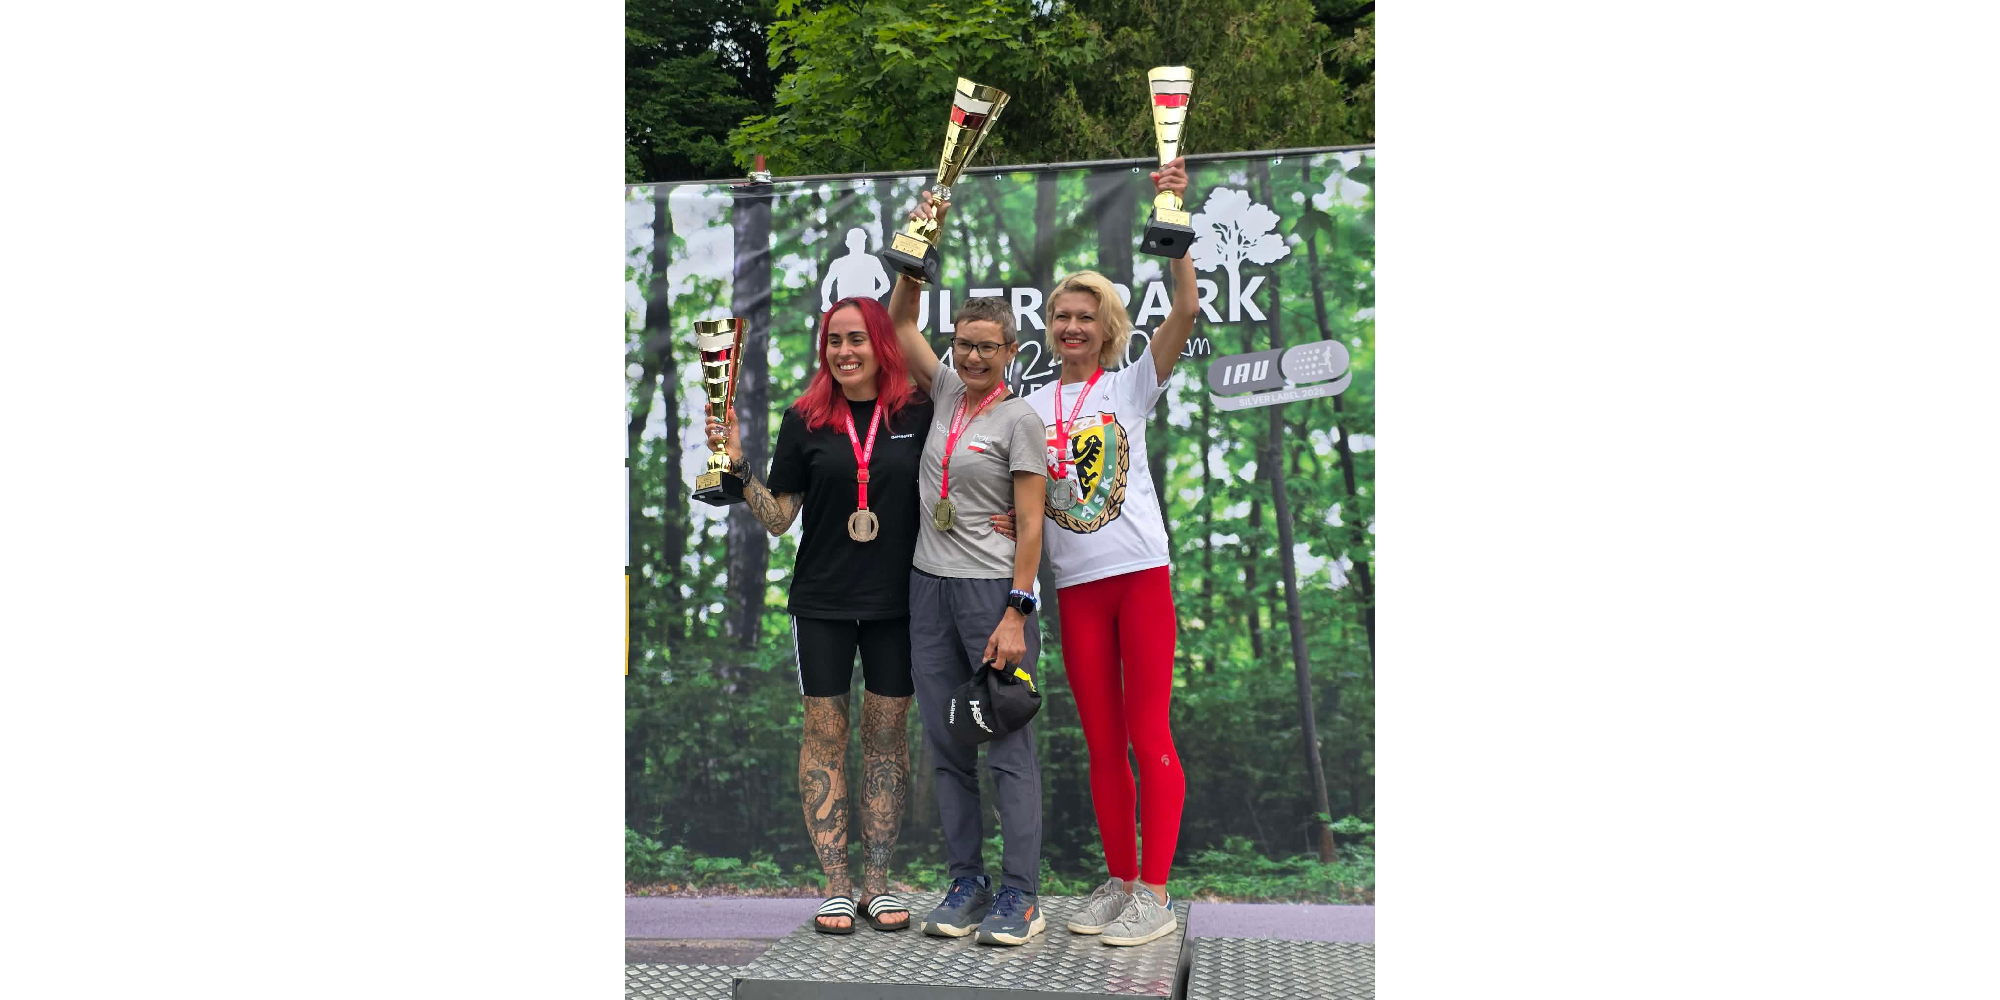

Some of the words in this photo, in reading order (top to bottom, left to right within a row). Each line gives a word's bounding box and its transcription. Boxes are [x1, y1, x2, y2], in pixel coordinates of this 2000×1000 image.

[1222, 359, 1270, 386] IAU
[1239, 394, 1271, 407] SILVER
[1271, 390, 1302, 402] LABEL
[1301, 387, 1326, 398] 2026
